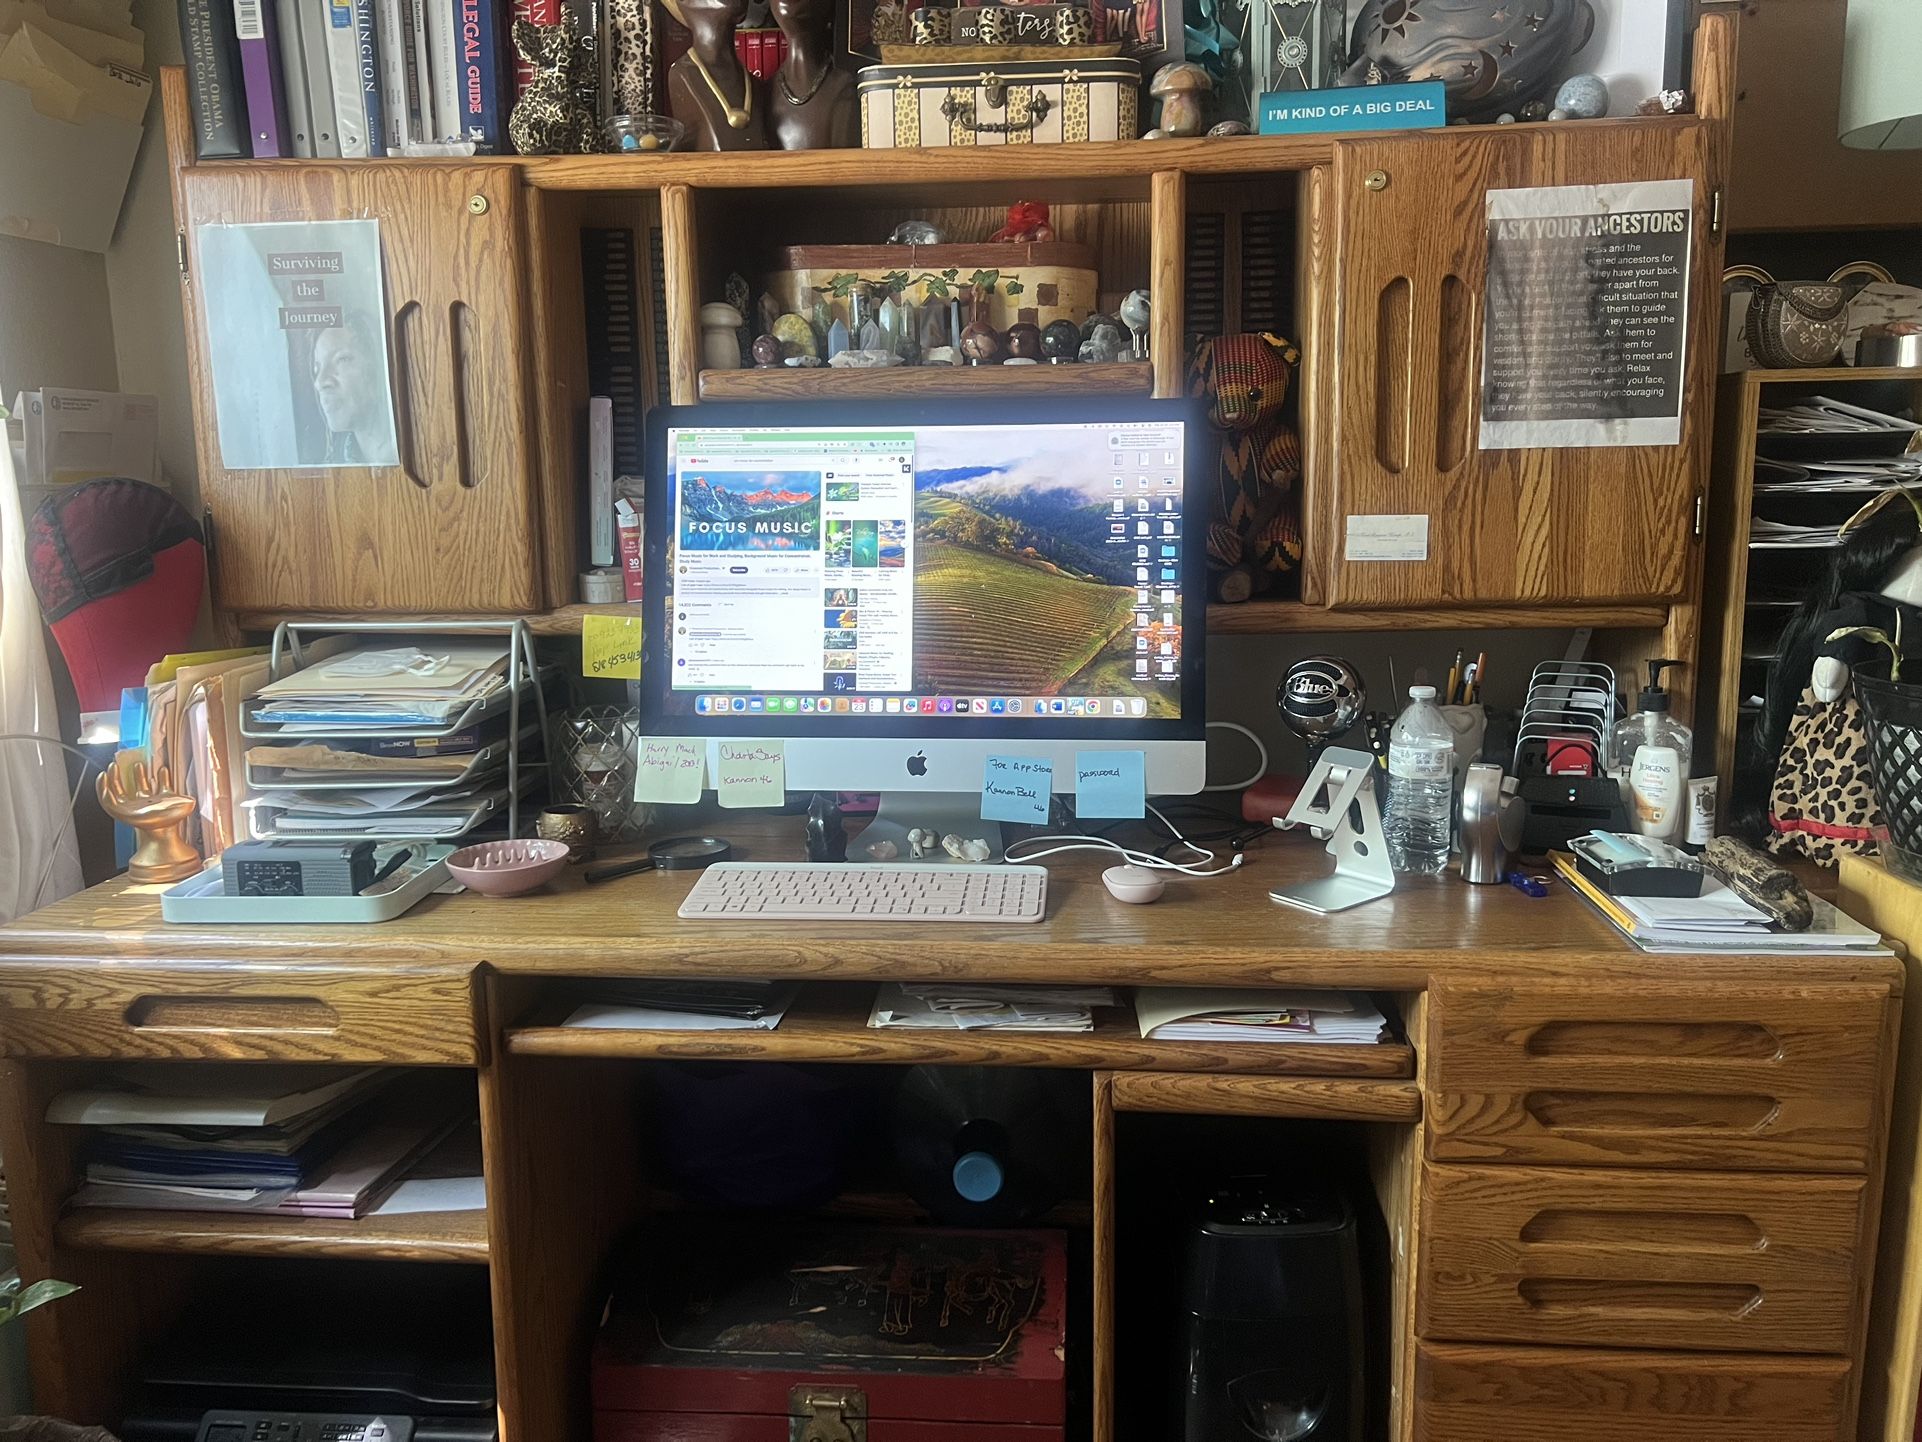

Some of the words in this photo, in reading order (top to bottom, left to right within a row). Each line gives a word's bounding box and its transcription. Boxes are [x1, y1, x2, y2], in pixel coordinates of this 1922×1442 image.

[413, 1, 422, 33] Solutions
[190, 18, 203, 57] STAMP
[200, 11, 218, 80] PRESIDENT
[209, 84, 224, 128] OBAMA
[467, 65, 482, 114] GUIDE
[196, 62, 214, 140] COLLECTION
[1268, 109, 1288, 121] I'M
[1291, 106, 1326, 119] KIND
[1329, 104, 1350, 117] OF
[1352, 103, 1363, 115] A
[1366, 102, 1392, 114] BIG
[1395, 99, 1435, 112] DEAL
[1497, 219, 1531, 241] ASK
[1531, 217, 1581, 239] YOUR
[1584, 212, 1685, 236] ANCESTORS
[1608, 244, 1626, 253] and
[1627, 243, 1641, 252] the
[273, 255, 340, 272] Surviving
[1617, 256, 1660, 265] ancestors
[1661, 254, 1675, 263] for
[1612, 267, 1634, 277] have
[1635, 267, 1656, 279] your
[1657, 265, 1681, 276] back.
[297, 282, 320, 296] the
[1613, 280, 1637, 291] apart
[1639, 279, 1659, 288] from
[1622, 292, 1659, 300] situation
[1660, 290, 1679, 299] that
[1606, 304, 1630, 313] them
[1631, 303, 1640, 312] to
[1641, 302, 1667, 315] guide
[285, 310, 338, 326] Journey
[1625, 316, 1642, 325] can
[1642, 316, 1658, 325] see
[1660, 315, 1675, 324] the
[1646, 328, 1656, 337] to
[1640, 339, 1653, 348] for
[1622, 352, 1631, 361] to
[1632, 351, 1655, 361] meet
[1656, 351, 1673, 360] and
[1569, 366, 1588, 374] time
[1589, 366, 1605, 377] you
[1626, 363, 1651, 373] Relax
[1626, 377, 1643, 388] you
[1644, 375, 1666, 386] face,
[1610, 387, 1665, 399] encouraging
[1491, 403, 1507, 414] you
[1508, 402, 1532, 413] every
[1579, 401, 1600, 412] way.
[688, 521, 747, 534] FOCUS
[754, 520, 813, 534] MUSIC
[629, 558, 640, 567] 30
[1293, 677, 1333, 695] Blue
[854, 703, 864, 711] 23
[646, 743, 669, 757] Harry
[1638, 762, 1671, 773] JERGENS
[723, 776, 758, 785] Kannon
[1079, 768, 1121, 782] password
